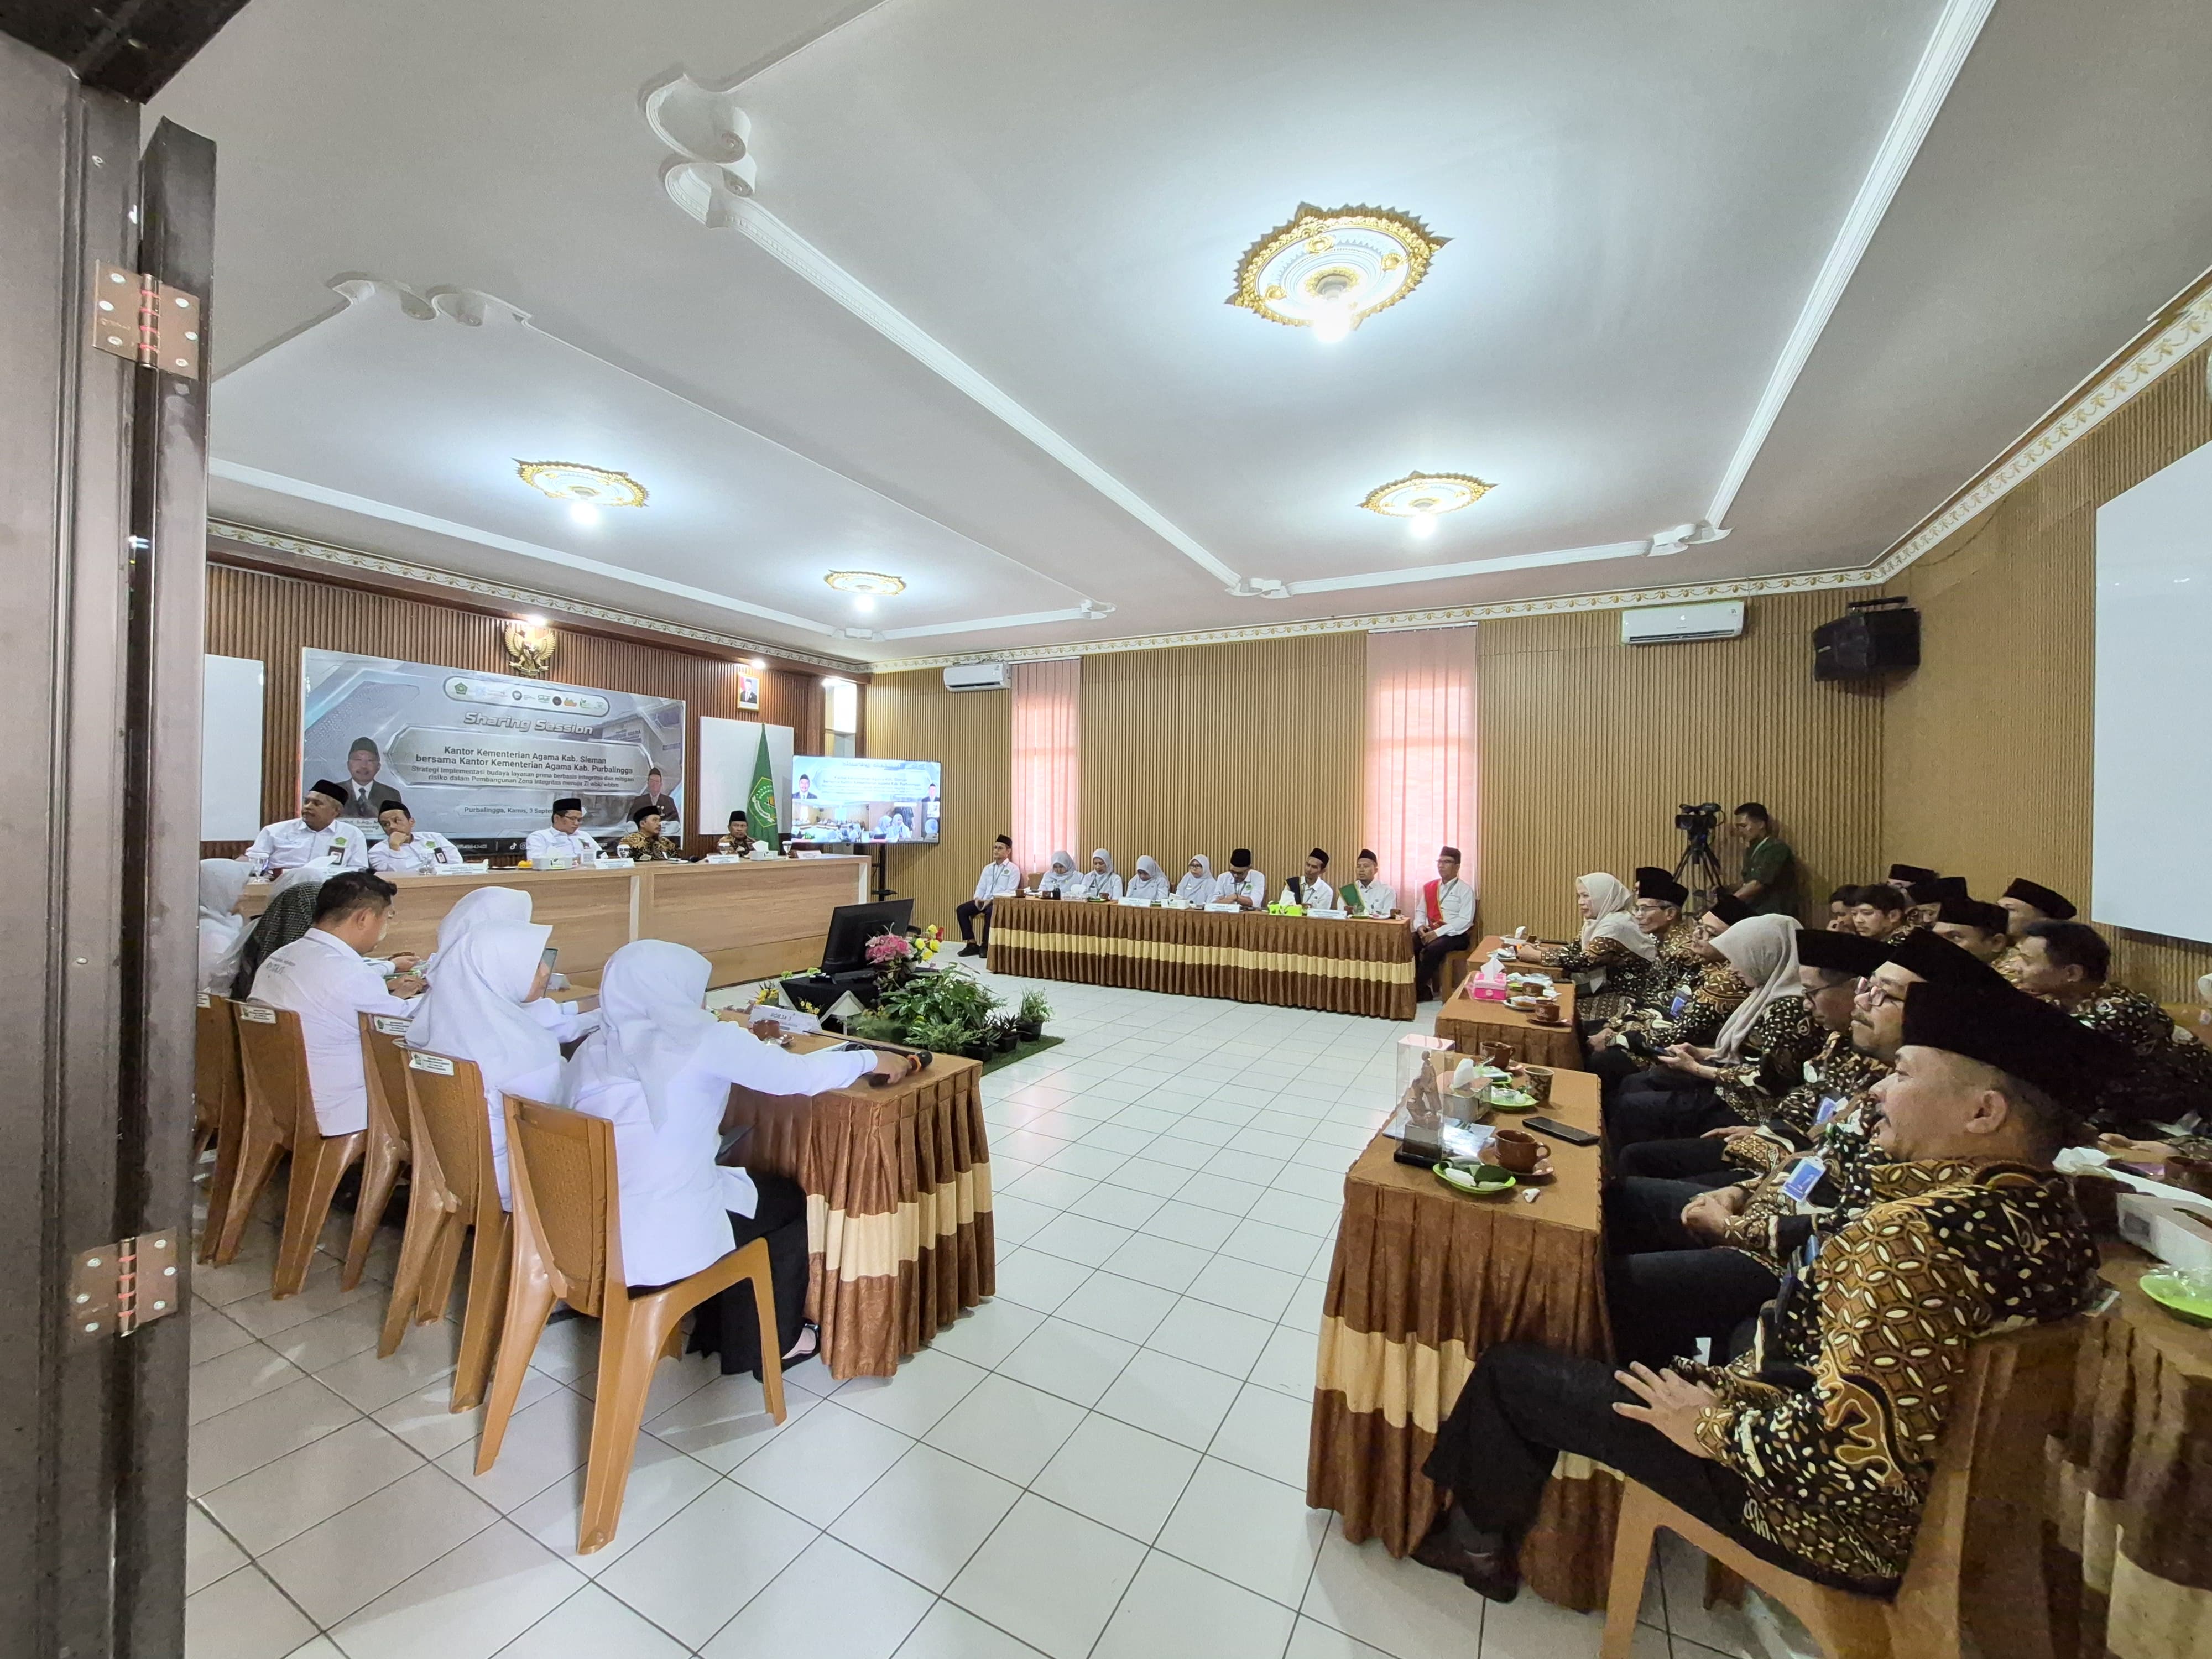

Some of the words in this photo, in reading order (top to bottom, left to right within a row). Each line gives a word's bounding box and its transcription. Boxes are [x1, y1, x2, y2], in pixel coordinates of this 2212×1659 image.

[463, 711, 531, 732] Sharing
[534, 719, 593, 735] Session
[444, 746, 474, 755] Kantor
[477, 748, 530, 759] Kementerian
[532, 753, 559, 762] Agama
[411, 765, 439, 774] Strategi
[415, 754, 456, 764] bersama
[460, 757, 489, 766] Kantor
[491, 759, 543, 769] Kementerian
[545, 762, 572, 771] Agama
[592, 765, 633, 774] Purbalingga
